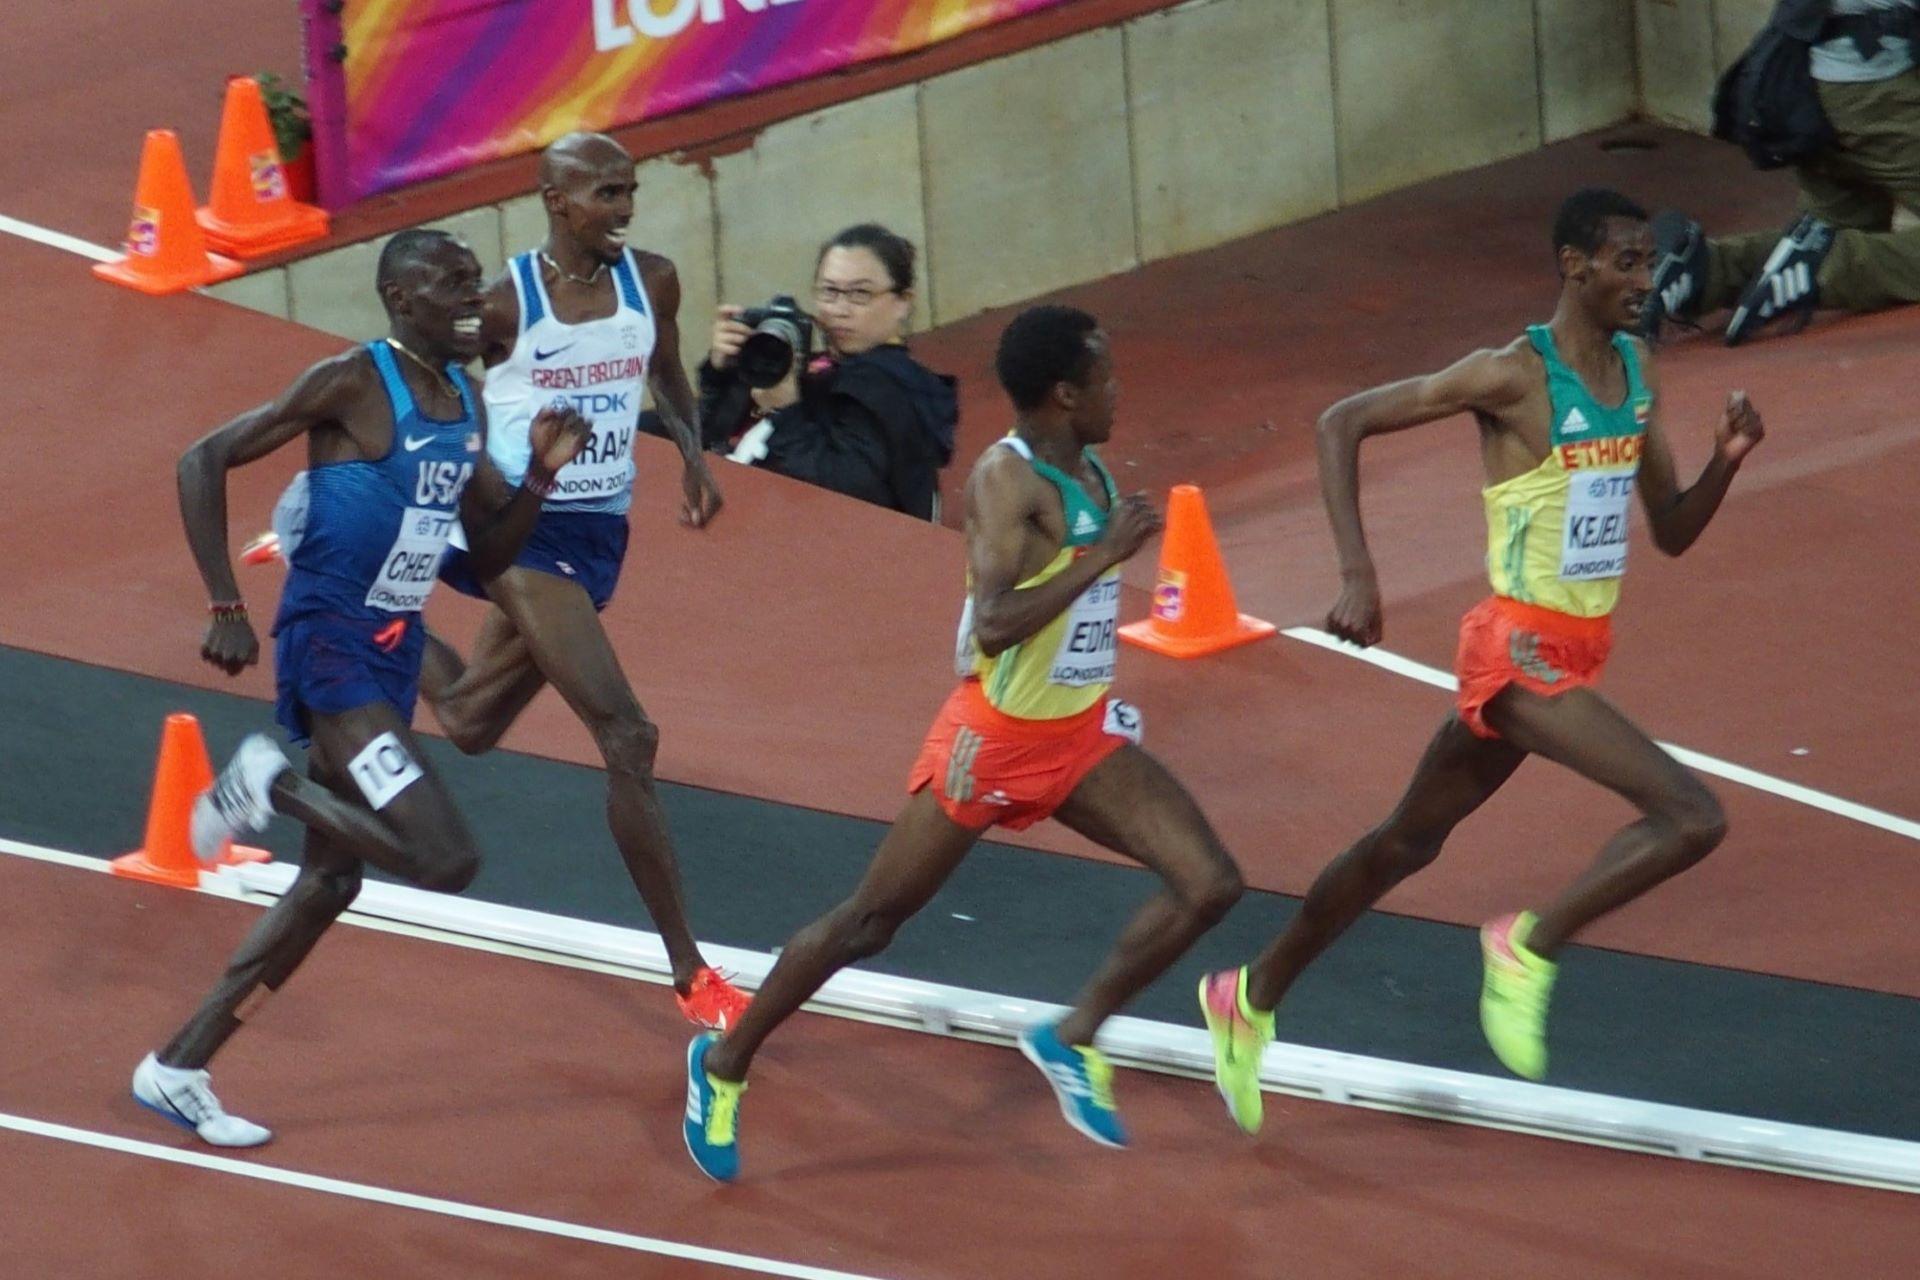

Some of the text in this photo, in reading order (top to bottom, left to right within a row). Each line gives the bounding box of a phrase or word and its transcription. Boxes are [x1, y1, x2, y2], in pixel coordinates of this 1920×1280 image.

[532, 354, 645, 389] GREAT BRITAIN
[571, 392, 628, 414] TDK
[572, 427, 631, 465] RAH
[416, 461, 474, 505] USA
[1562, 558, 1615, 576] LONDON
[370, 589, 421, 607] LONDON
[1053, 666, 1104, 681] LONDON
[361, 745, 410, 791] 10
